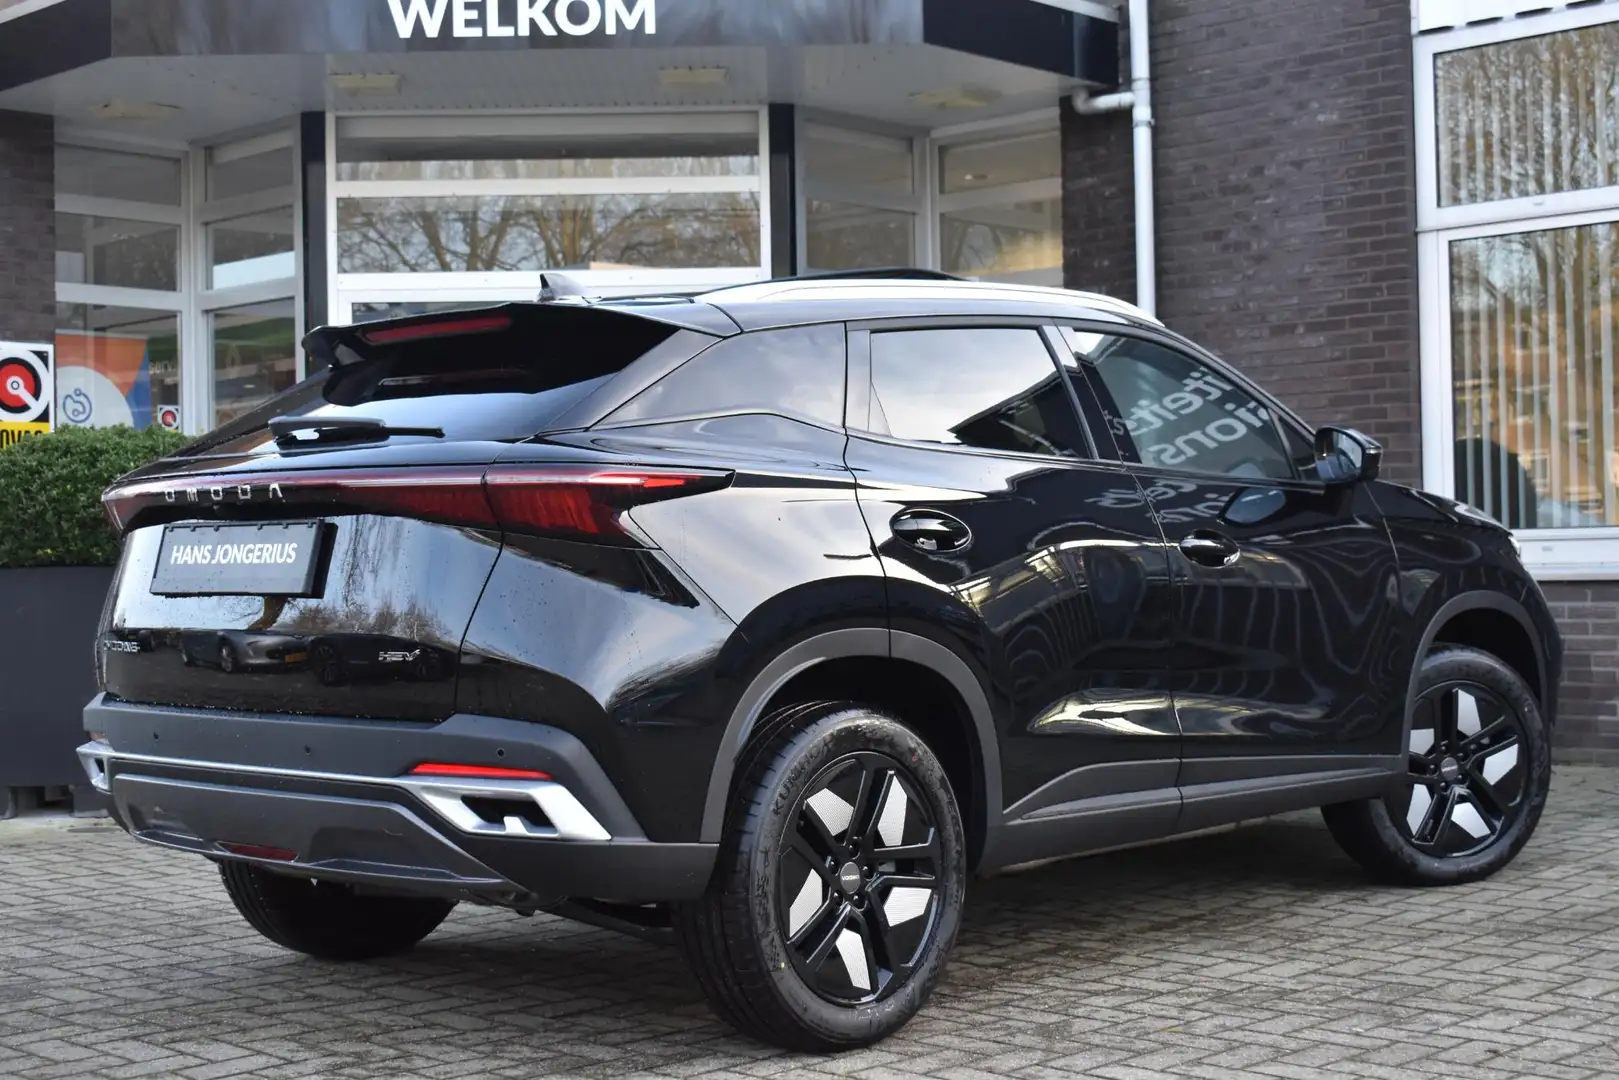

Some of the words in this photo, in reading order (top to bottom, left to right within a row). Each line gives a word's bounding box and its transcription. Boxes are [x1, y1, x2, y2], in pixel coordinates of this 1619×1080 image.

[387, 0, 657, 39] WELKOM
[165, 483, 286, 503] OMODA
[170, 545, 211, 565] HANS
[211, 543, 298, 564] JONGERIUS
